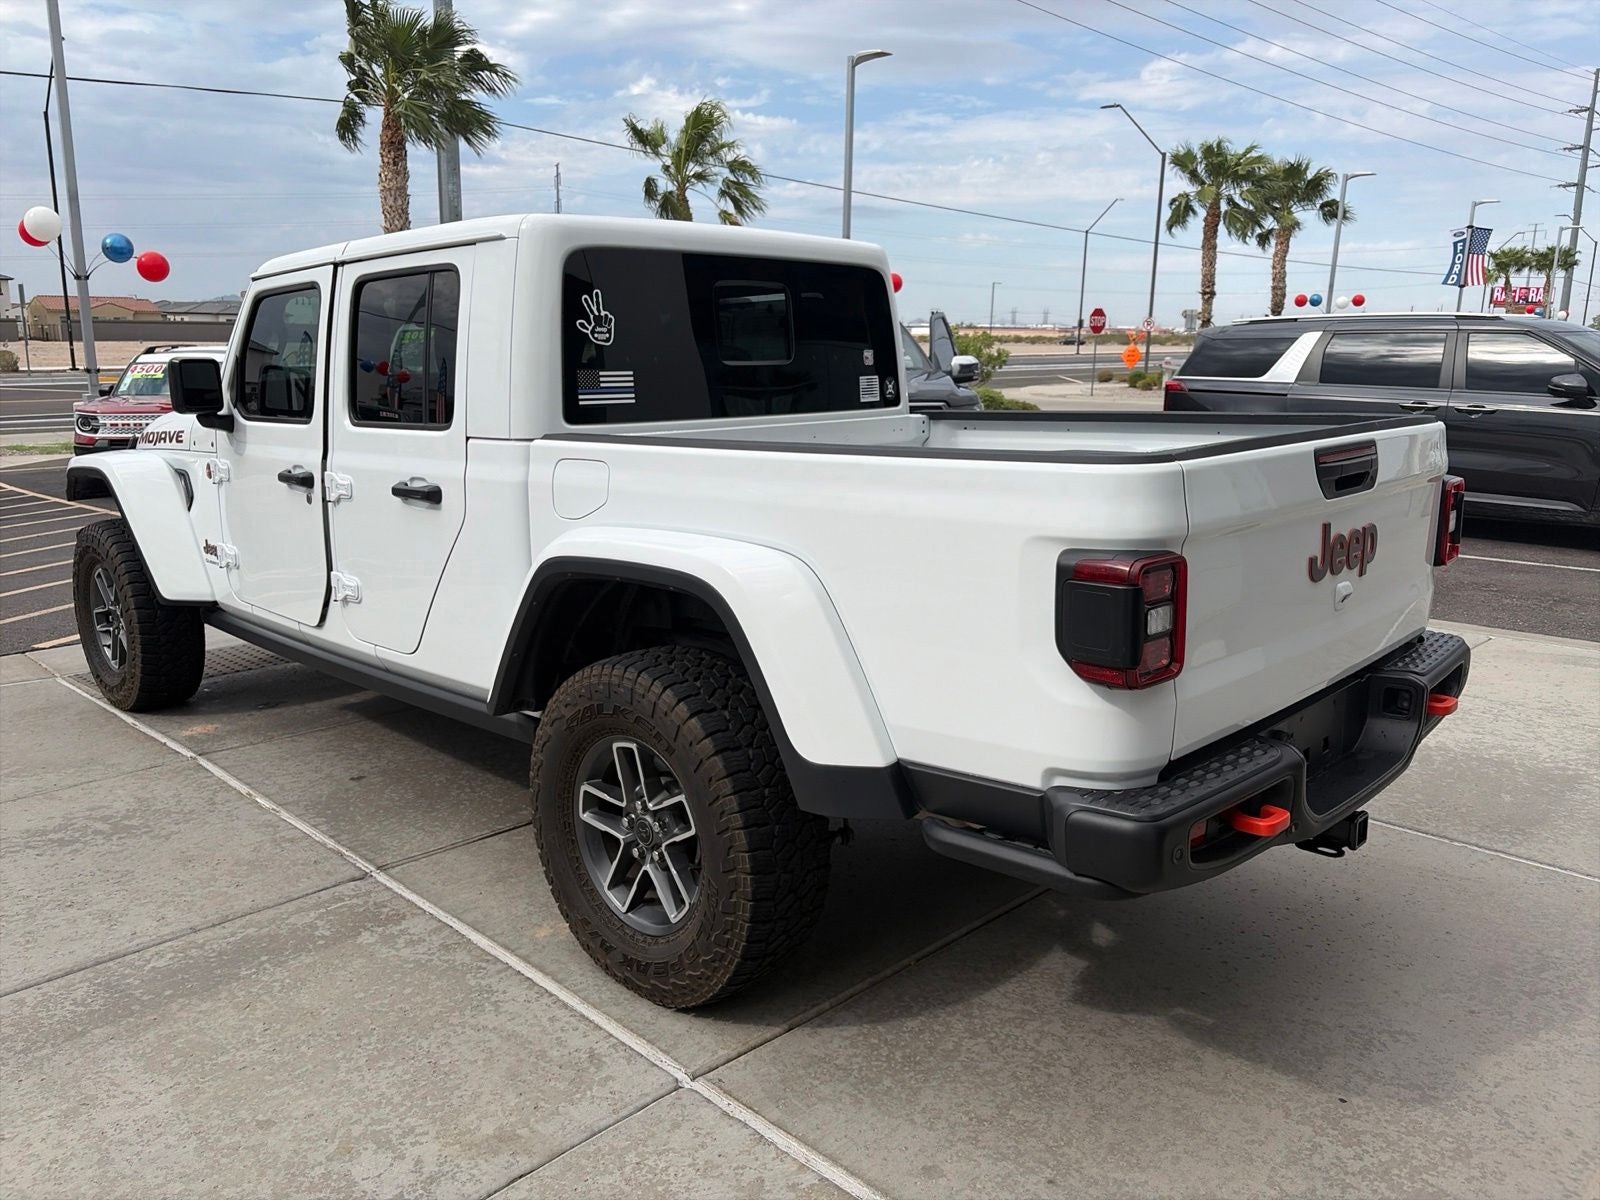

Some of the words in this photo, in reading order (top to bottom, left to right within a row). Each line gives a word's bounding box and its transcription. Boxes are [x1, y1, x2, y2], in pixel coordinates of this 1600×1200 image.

[1447, 242, 1463, 284] FORD
[1528, 287, 1555, 303] RAI
[1090, 316, 1106, 327] STOP
[138, 430, 184, 447] MOJAVE
[1308, 521, 1378, 583] Jeep
